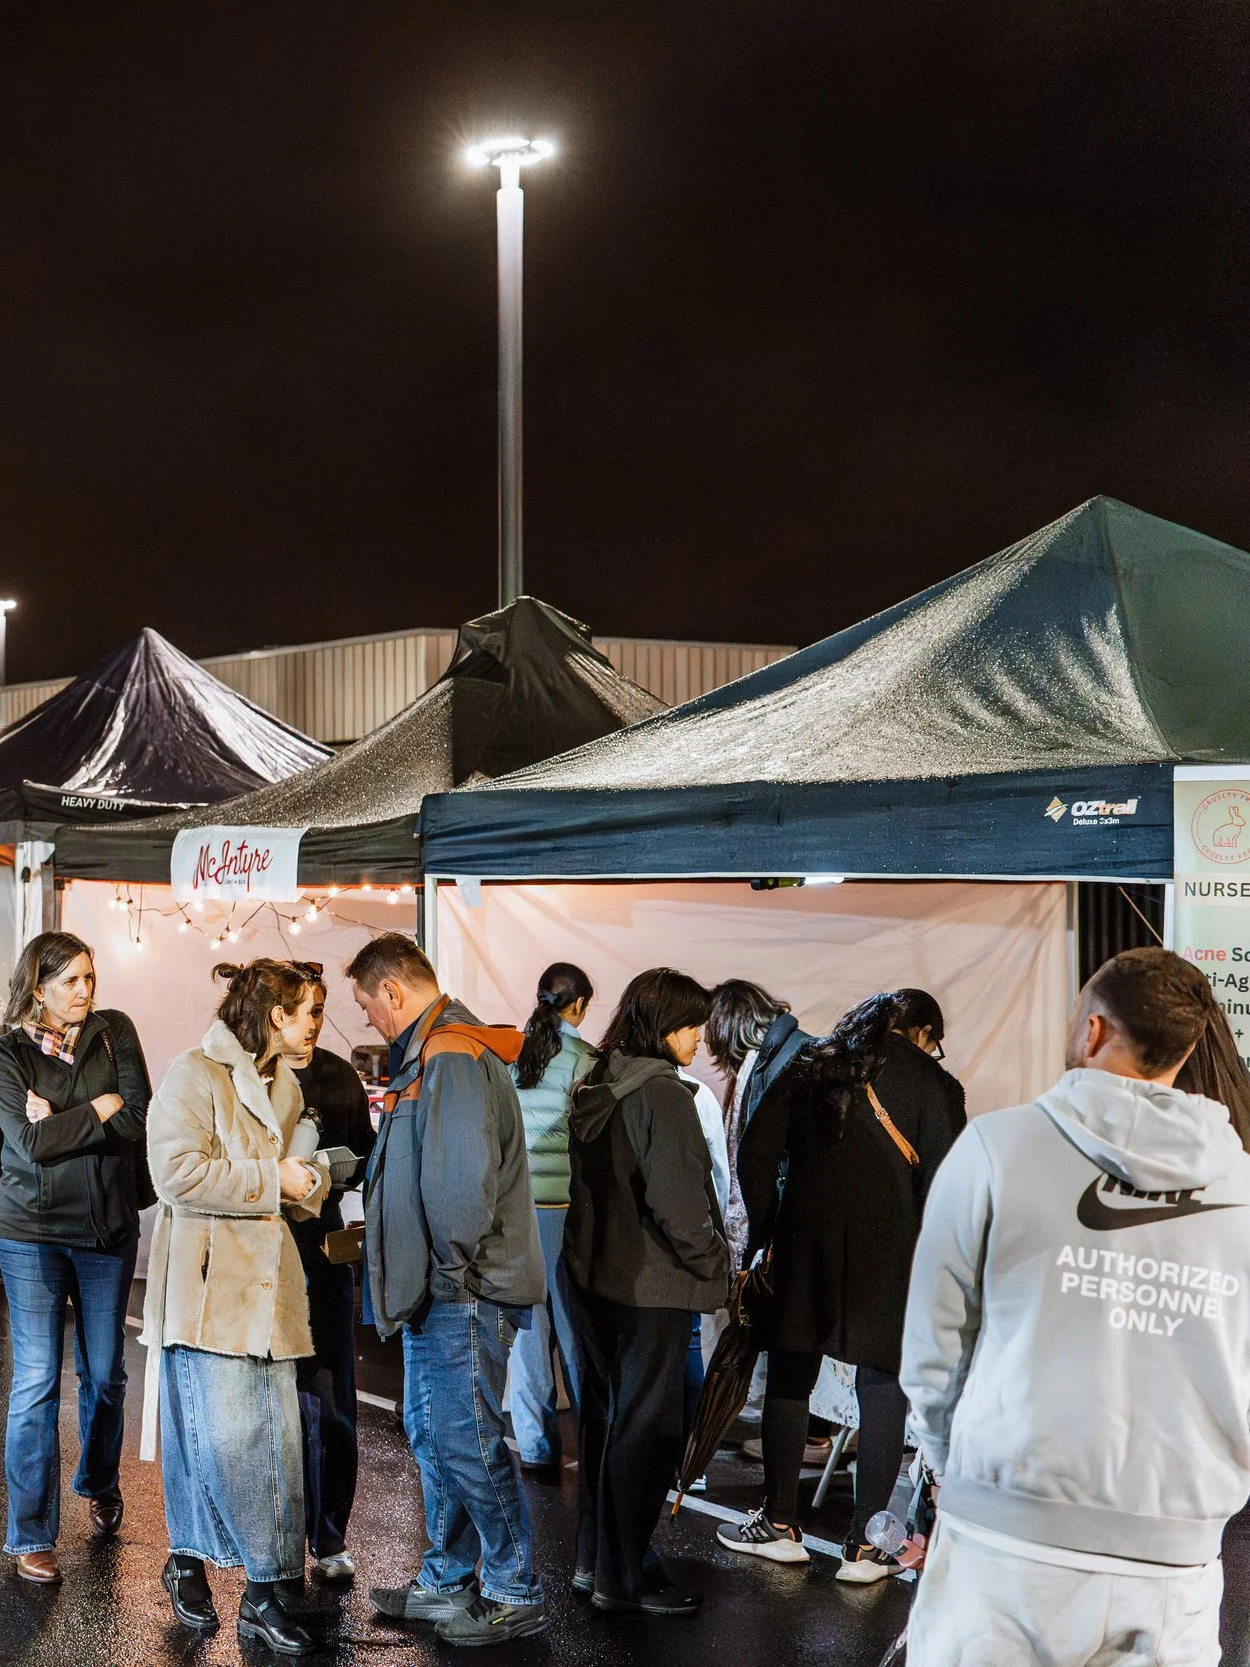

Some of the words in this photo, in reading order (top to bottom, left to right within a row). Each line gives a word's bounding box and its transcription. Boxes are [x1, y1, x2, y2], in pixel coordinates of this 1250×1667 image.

[61, 796, 96, 809] HEAVY
[97, 799, 125, 811] DUTY
[1071, 799, 1138, 816] OZtrail
[1202, 792, 1237, 810] CRUELTY
[1073, 818, 1098, 826] Deluxe
[1201, 844, 1234, 861] CRUELTY
[193, 840, 273, 892] McIntyre
[1185, 882, 1250, 897] NURSE
[1183, 946, 1226, 961] Acne
[1206, 972, 1250, 992] i-Ag
[1056, 1245, 1239, 1296] AUTHORIZED
[1060, 1272, 1226, 1321] PERSONNEL
[1109, 1307, 1184, 1337] ONLY
